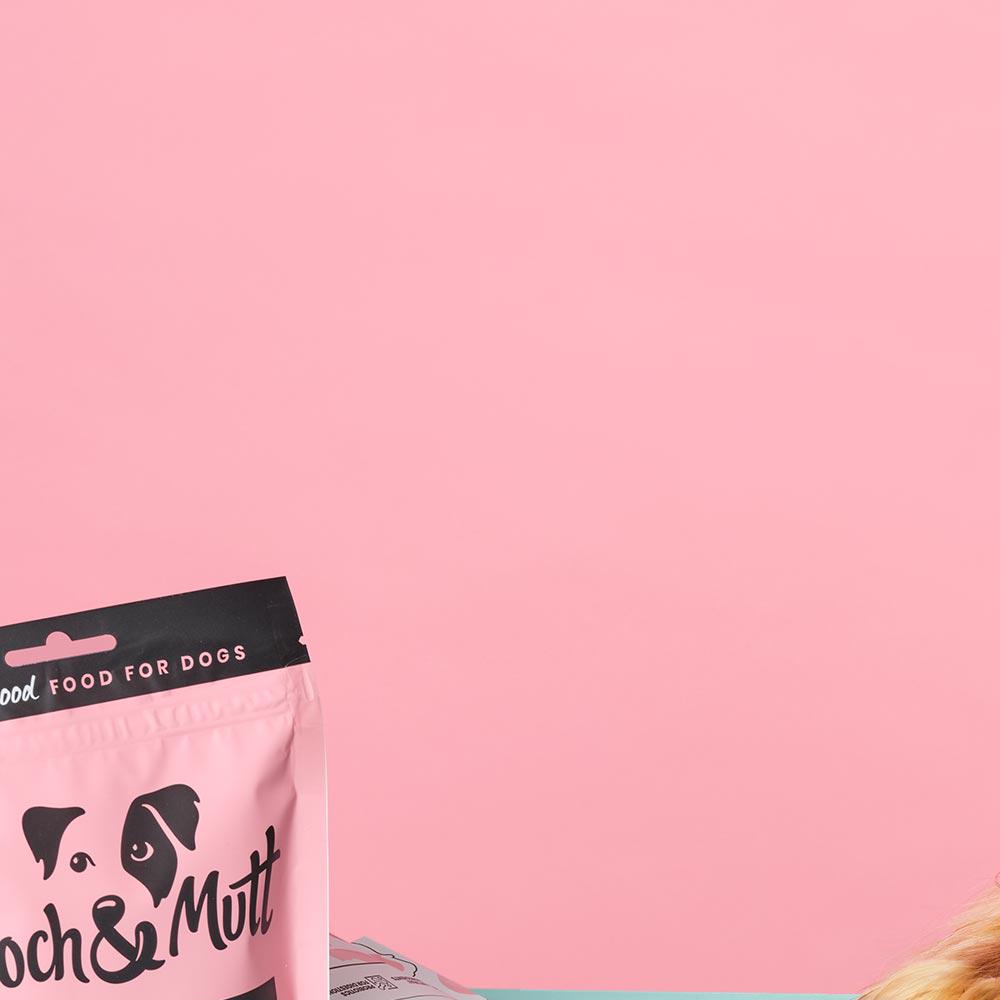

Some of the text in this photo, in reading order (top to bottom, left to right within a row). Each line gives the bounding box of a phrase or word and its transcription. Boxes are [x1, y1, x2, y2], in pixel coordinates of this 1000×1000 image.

[49, 669, 113, 695] FOOD
[124, 658, 169, 681] FOR
[180, 645, 247, 672] DOGS
[169, 825, 281, 957] Mutt
